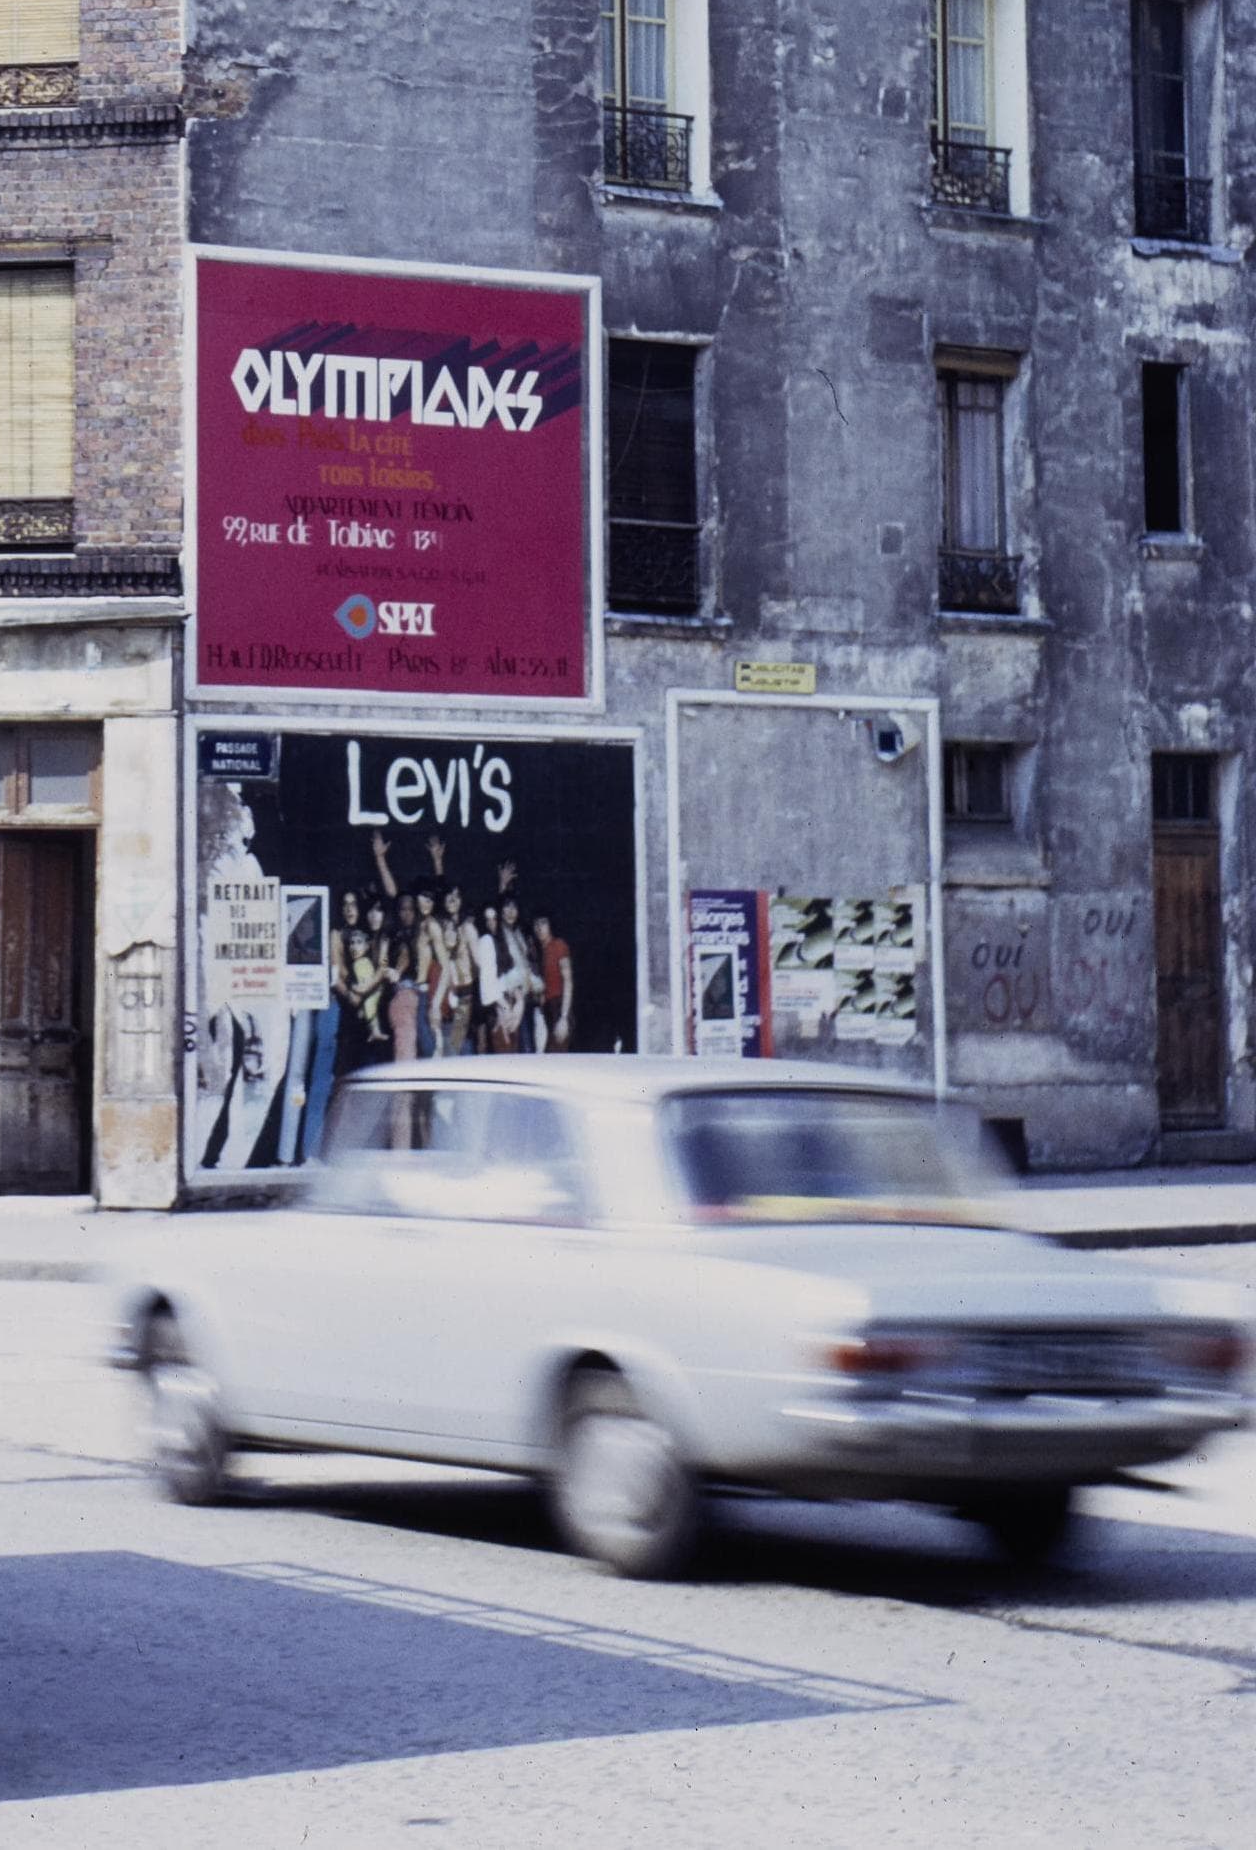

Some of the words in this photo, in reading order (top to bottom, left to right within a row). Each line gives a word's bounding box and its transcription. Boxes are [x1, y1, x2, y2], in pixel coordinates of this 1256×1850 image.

[230, 348, 544, 432] OLYMPIADES
[215, 742, 258, 755] PASSAGE
[211, 758, 262, 772] NATIONAL
[347, 740, 513, 833] Levi's
[213, 883, 276, 901] RETRAIT
[230, 922, 277, 940] TROUPES
